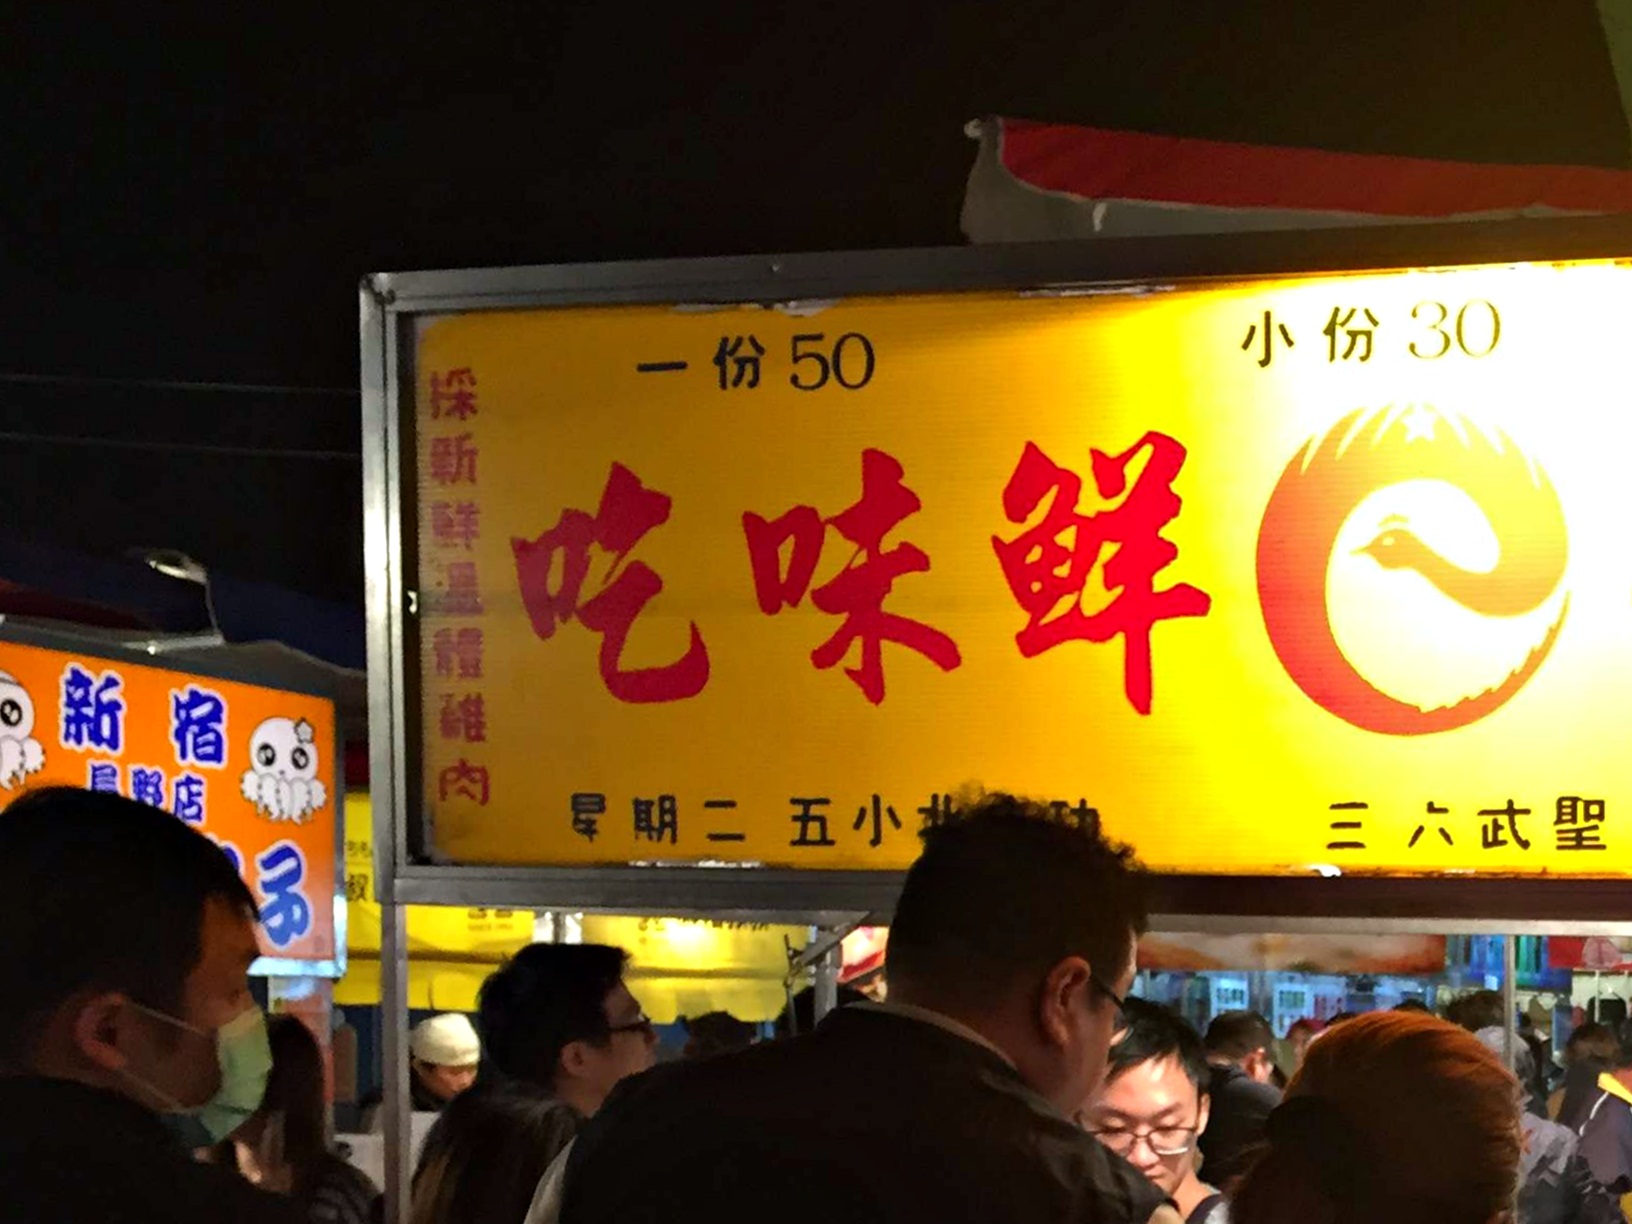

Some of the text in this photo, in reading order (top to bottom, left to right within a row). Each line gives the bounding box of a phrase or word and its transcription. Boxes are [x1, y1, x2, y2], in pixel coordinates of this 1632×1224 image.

[510, 430, 1212, 717] 吃味鮮
[62, 667, 226, 764] 新宿
[1325, 794, 1609, 853] 三六武聖
